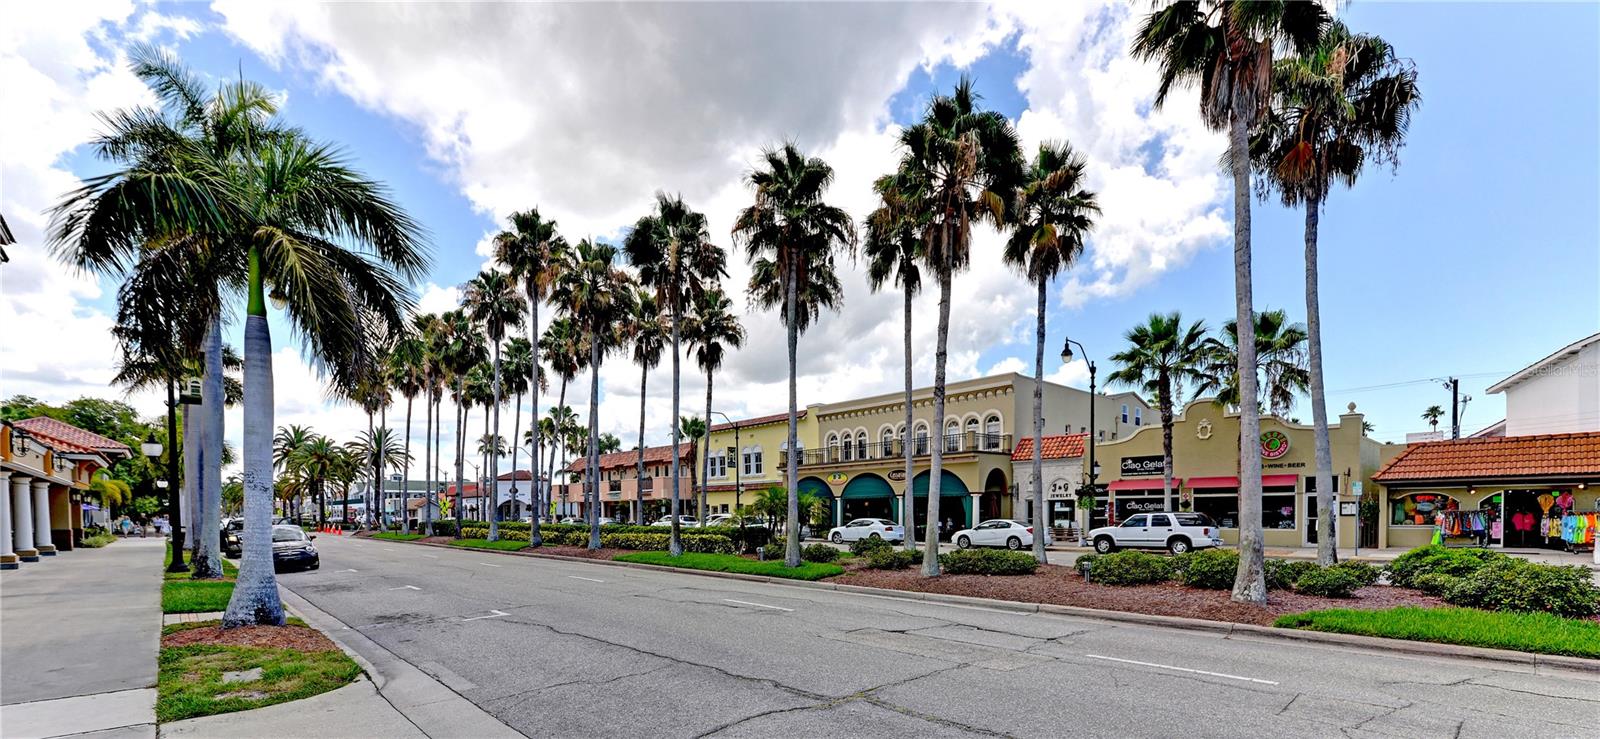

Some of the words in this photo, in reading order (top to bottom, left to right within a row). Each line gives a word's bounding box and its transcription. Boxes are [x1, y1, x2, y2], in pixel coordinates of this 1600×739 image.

[1121, 461, 1141, 469] Ciao
[1142, 460, 1165, 468] Gelat
[1063, 483, 1069, 492] G
[1126, 501, 1143, 509] Ciao
